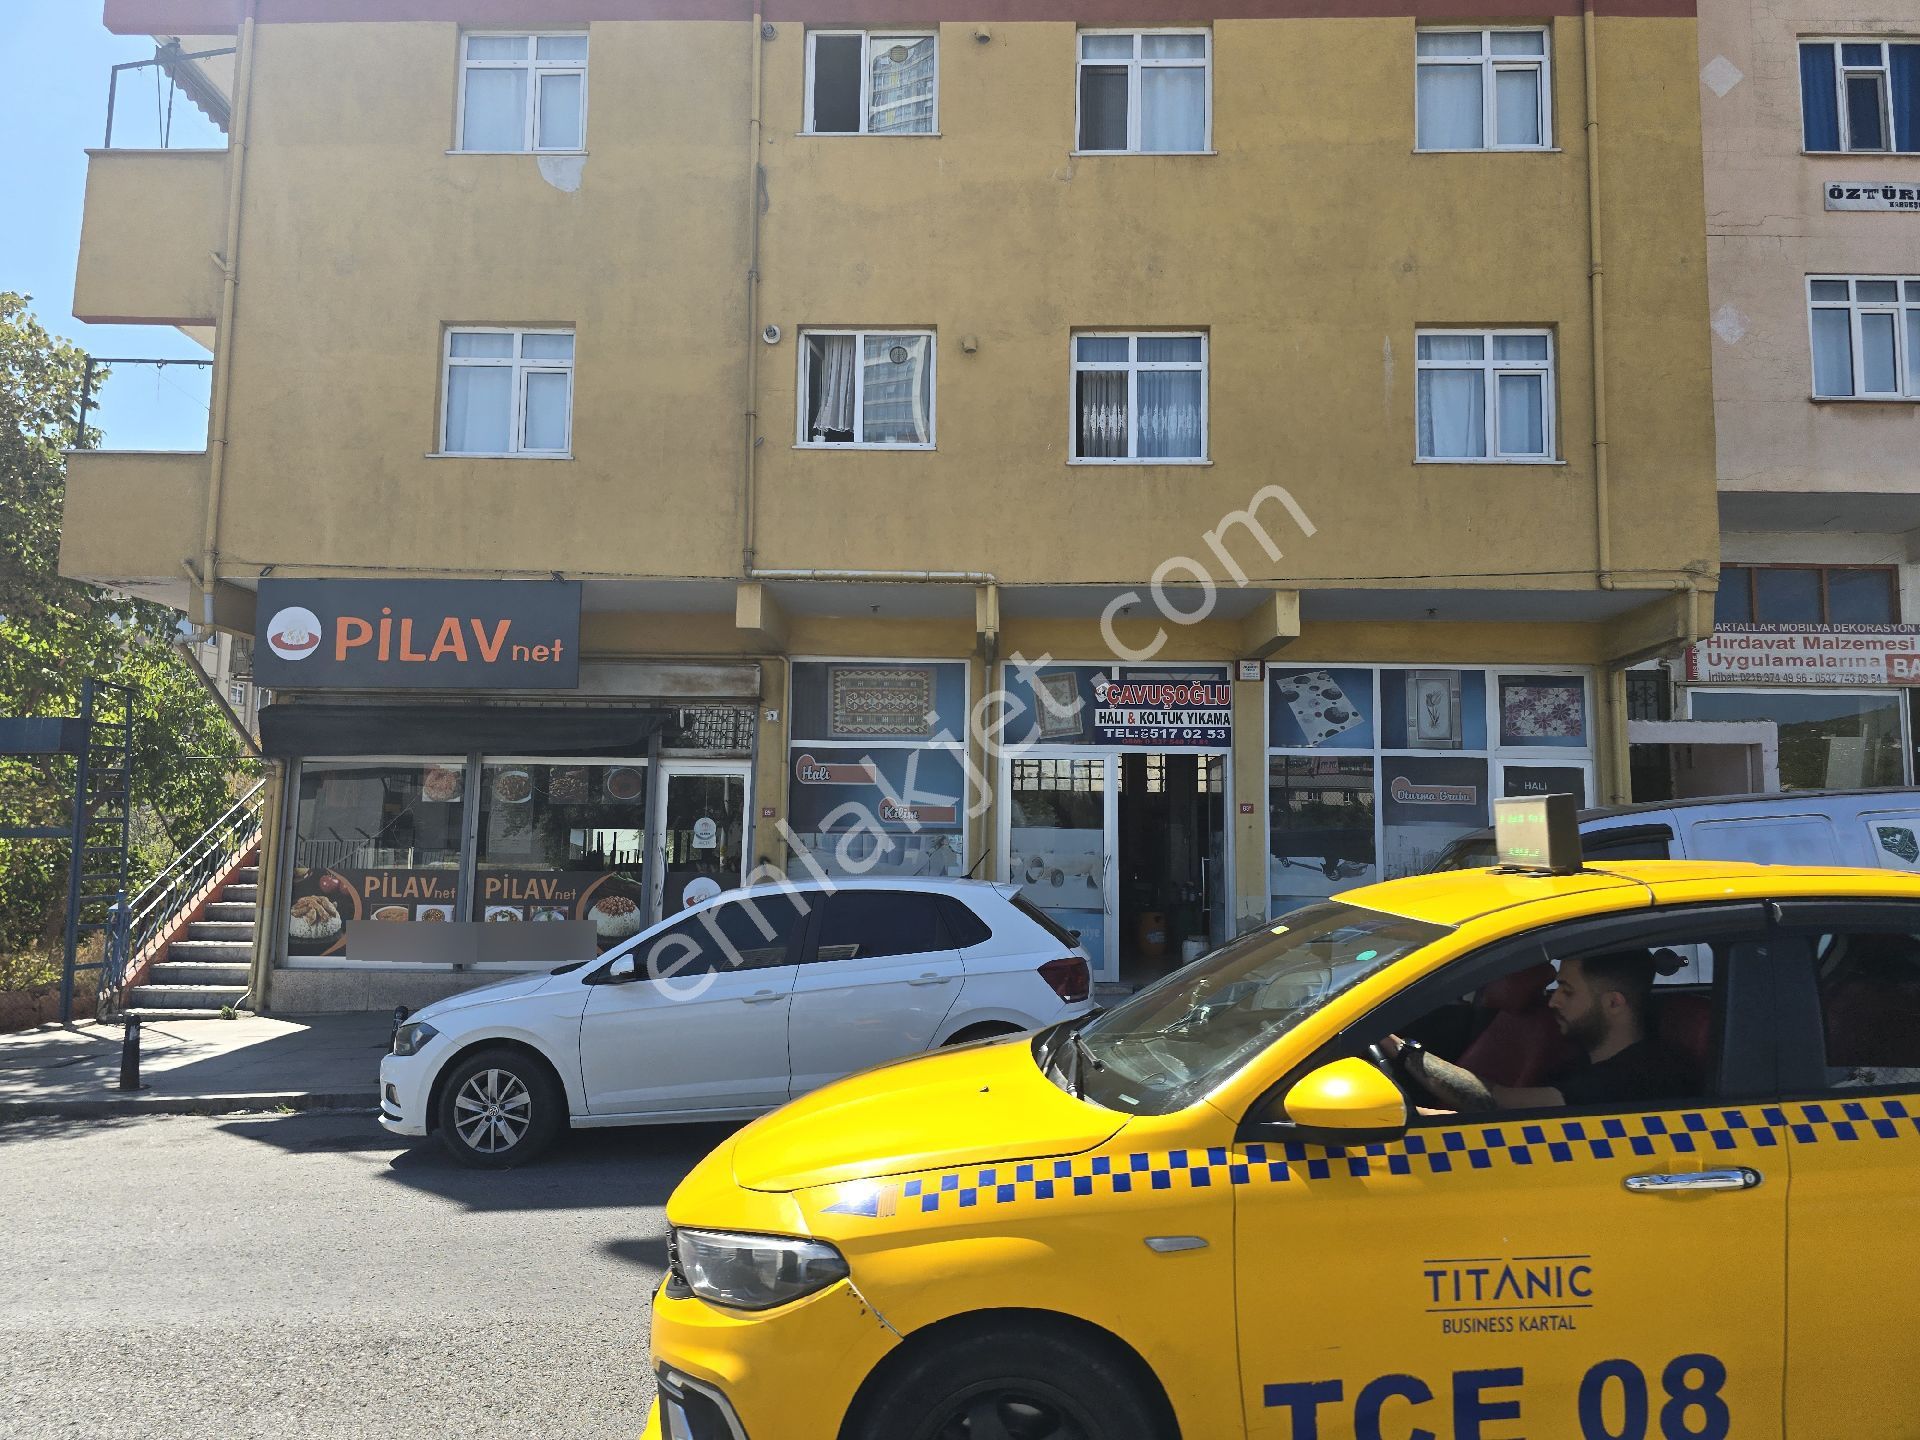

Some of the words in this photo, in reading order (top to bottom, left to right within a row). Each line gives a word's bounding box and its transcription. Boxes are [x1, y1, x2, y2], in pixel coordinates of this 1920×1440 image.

[1828, 184, 1920, 201] ÖZTÜR
[1713, 622, 1777, 632] ARTALLAR
[1780, 623, 1831, 633] MOBİLYA
[1833, 623, 1916, 633] DEKORASYON
[1706, 635, 1796, 650] Hırdavat
[1802, 636, 1916, 651] Malzemesi
[1707, 652, 1881, 670] Uygulamalarına
[1764, 672, 1780, 683] 374
[1106, 680, 1231, 710] ÇAVUŞOĞLU
[1098, 711, 1124, 725] HALI
[1127, 711, 1136, 725] &
[1139, 712, 1184, 725] KOLTUK
[1186, 712, 1231, 726] YIKAMA
[1103, 728, 1139, 738] TEL:
[1182, 729, 1202, 739] 02
[1206, 729, 1226, 739] 53
[1397, 790, 1437, 801] Oturma
[1440, 791, 1472, 802] Grubu
[883, 806, 919, 820] Kilim
[1424, 1264, 1593, 1302] TITANIC
[1442, 1316, 1515, 1334] BUSINESS
[1519, 1315, 1577, 1332] KARTAL
[1263, 1366, 1526, 1440] TCE
[1578, 1353, 1731, 1440] 08
